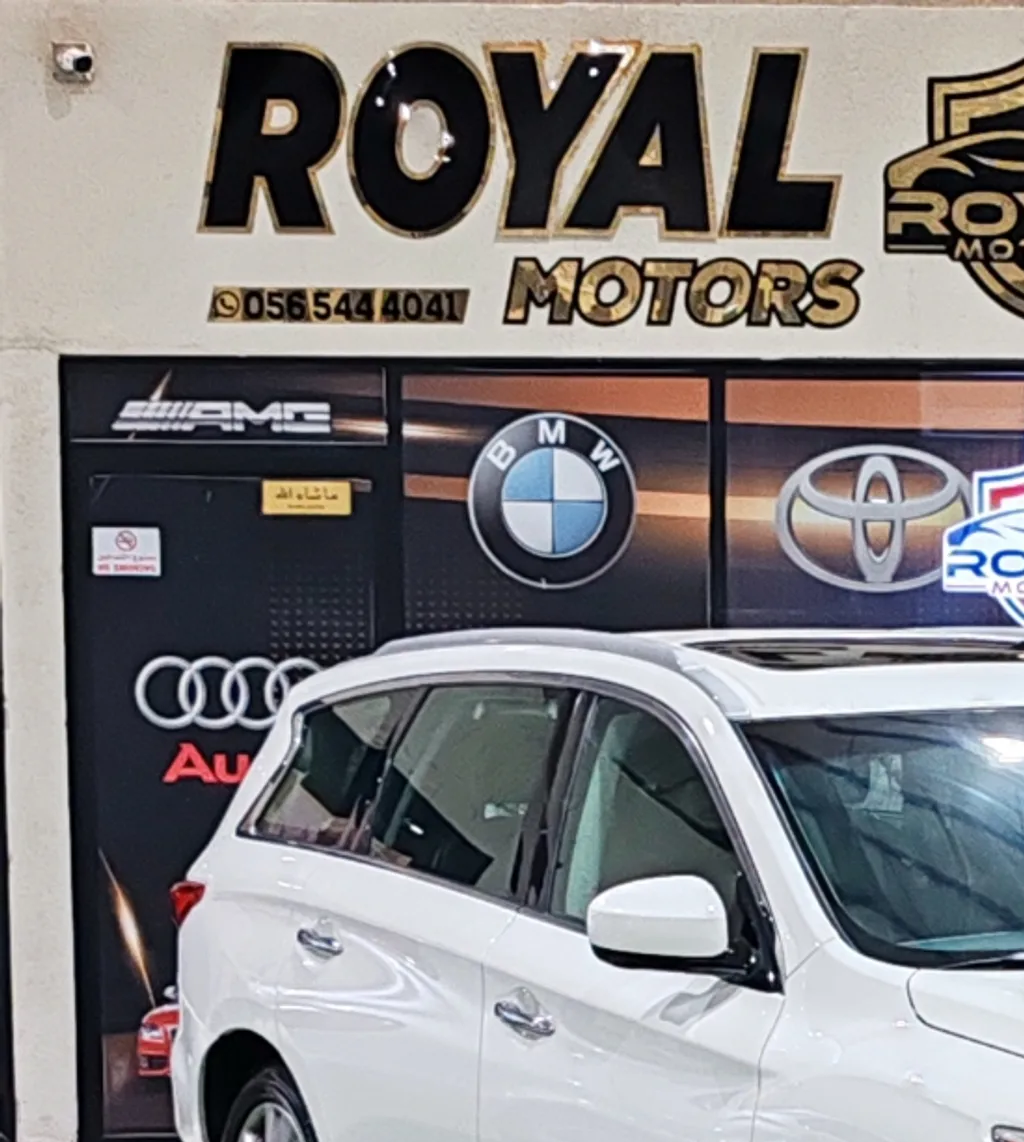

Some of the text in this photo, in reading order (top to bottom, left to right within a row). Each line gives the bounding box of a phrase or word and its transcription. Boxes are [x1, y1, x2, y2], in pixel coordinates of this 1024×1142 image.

[197, 40, 842, 241] ROYAL
[502, 257, 865, 328] MOTORS
[183, 401, 331, 433] AMG
[487, 419, 621, 472] BMW
[163, 742, 250, 784] Au
